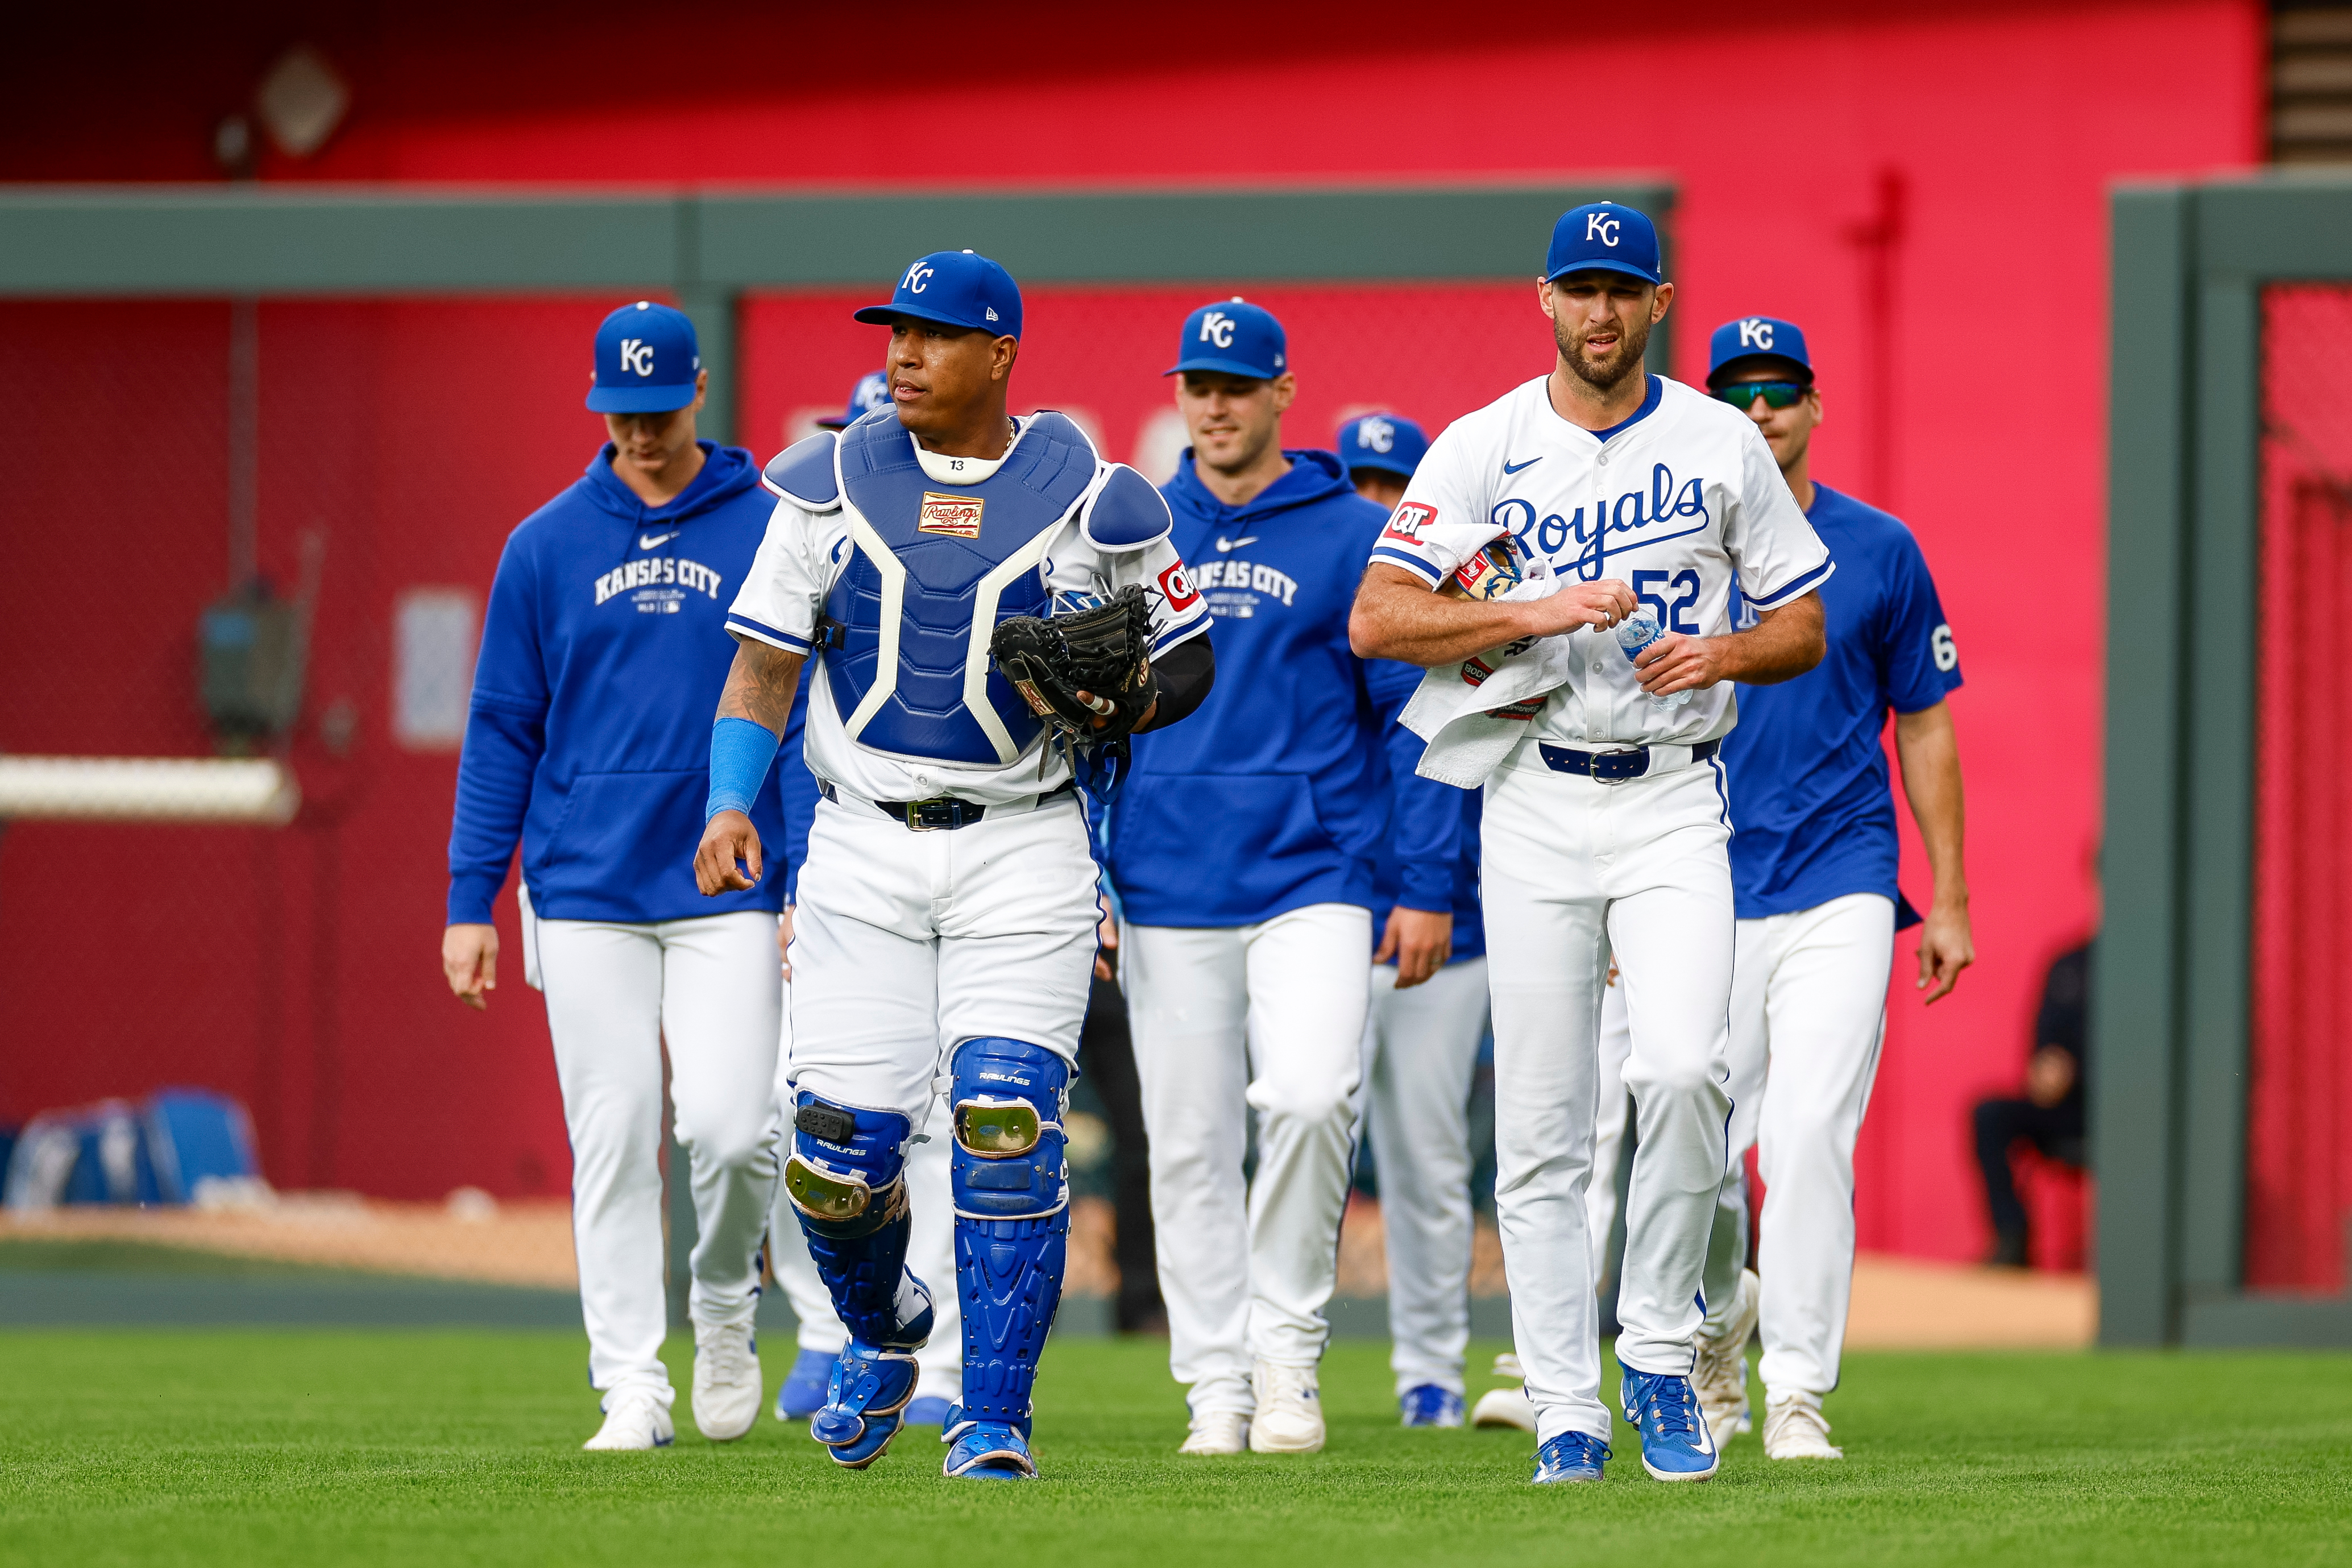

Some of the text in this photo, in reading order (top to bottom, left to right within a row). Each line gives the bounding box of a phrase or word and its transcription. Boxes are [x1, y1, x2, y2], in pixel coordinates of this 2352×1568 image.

[1586, 213, 1620, 247] KC
[902, 262, 934, 293] KC
[1200, 312, 1235, 348] KC
[1740, 319, 1773, 350] KC
[621, 338, 654, 377] KC
[1358, 417, 1395, 453] KC
[950, 460, 964, 471] 13
[923, 505, 979, 524] Rawlings
[1392, 505, 1429, 534] QT
[1492, 463, 1709, 582] Royals
[594, 557, 722, 606] KANSAS CITY
[1252, 563, 1299, 607] CITY
[1632, 569, 1700, 634] 52
[1931, 624, 1957, 673] 6
[1465, 663, 1490, 680] BODY
[979, 1072, 1031, 1086] RAWLINGS
[816, 1138, 867, 1156] RAWLINGS
